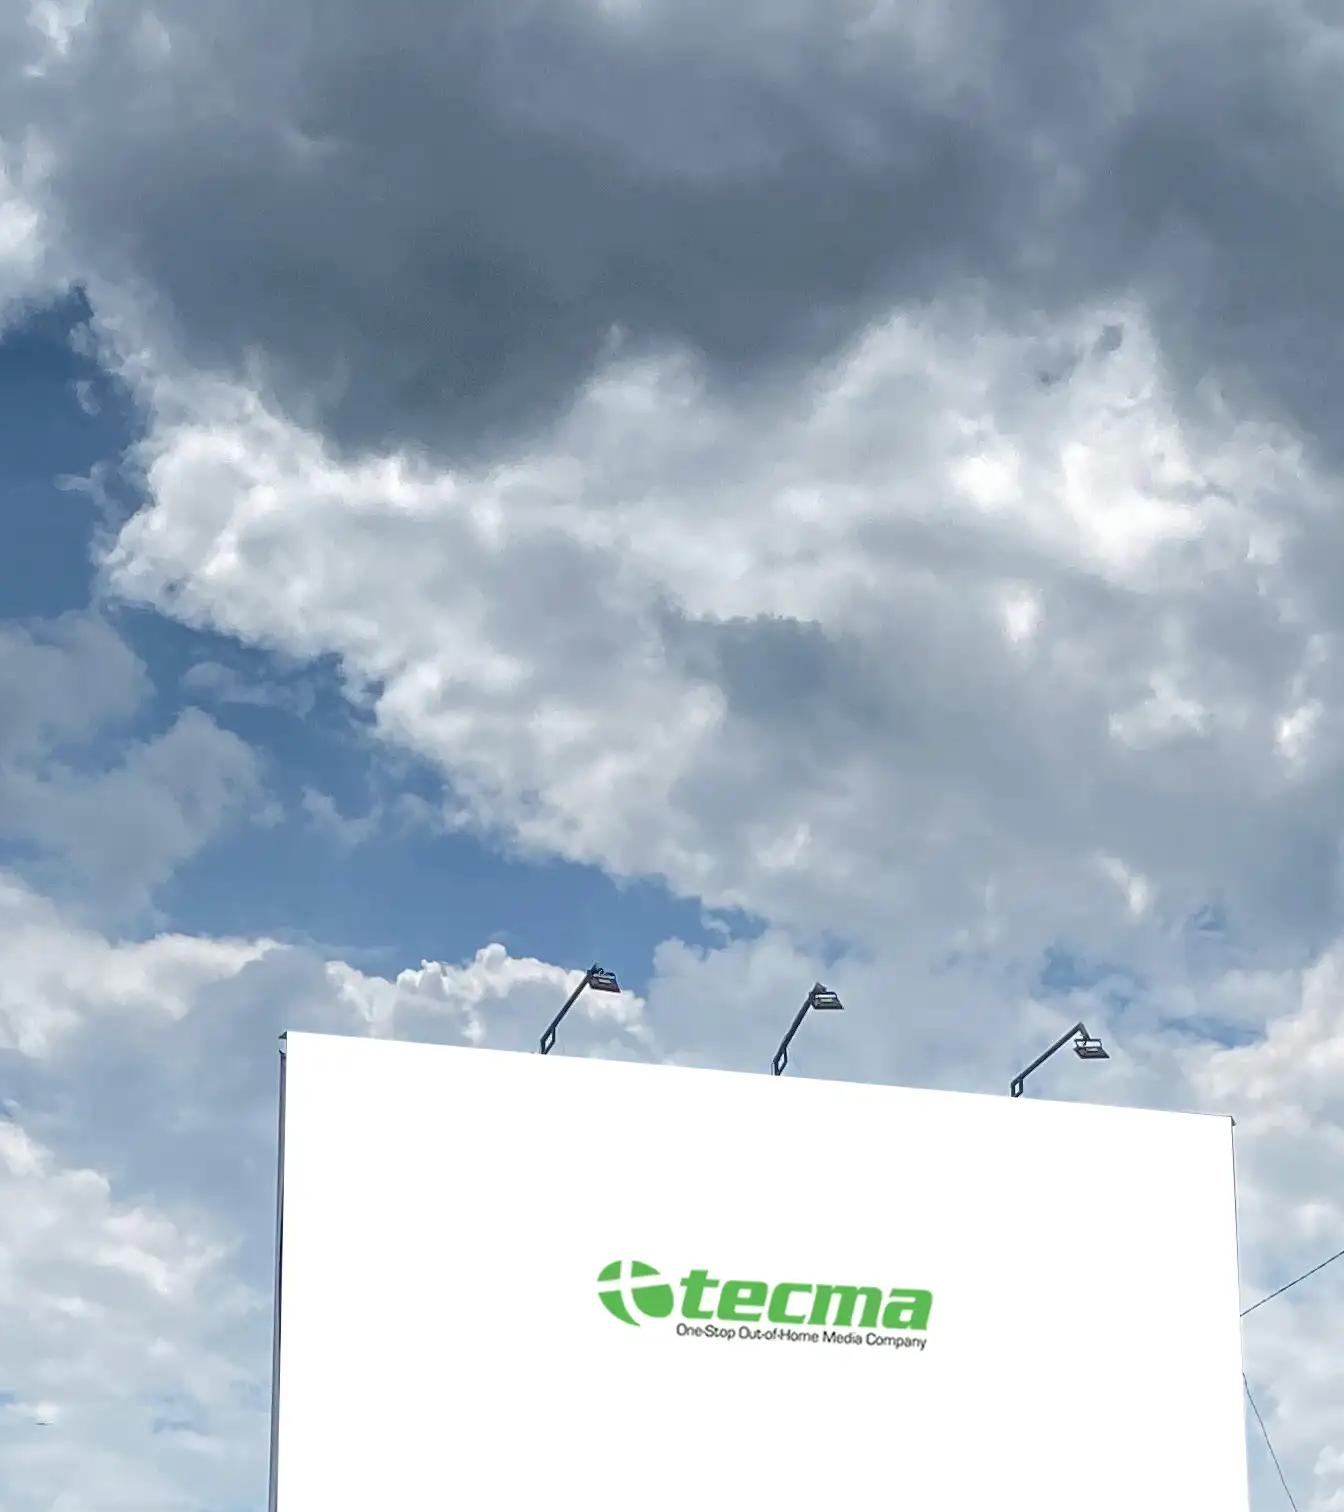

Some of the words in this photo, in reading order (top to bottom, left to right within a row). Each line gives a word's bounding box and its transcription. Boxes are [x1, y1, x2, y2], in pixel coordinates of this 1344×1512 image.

[680, 1270, 934, 1331] tecma
[676, 1323, 736, 1341] One-Stop
[738, 1326, 819, 1342] Out-of-Home
[822, 1331, 863, 1346] Media
[865, 1332, 927, 1352] Company
